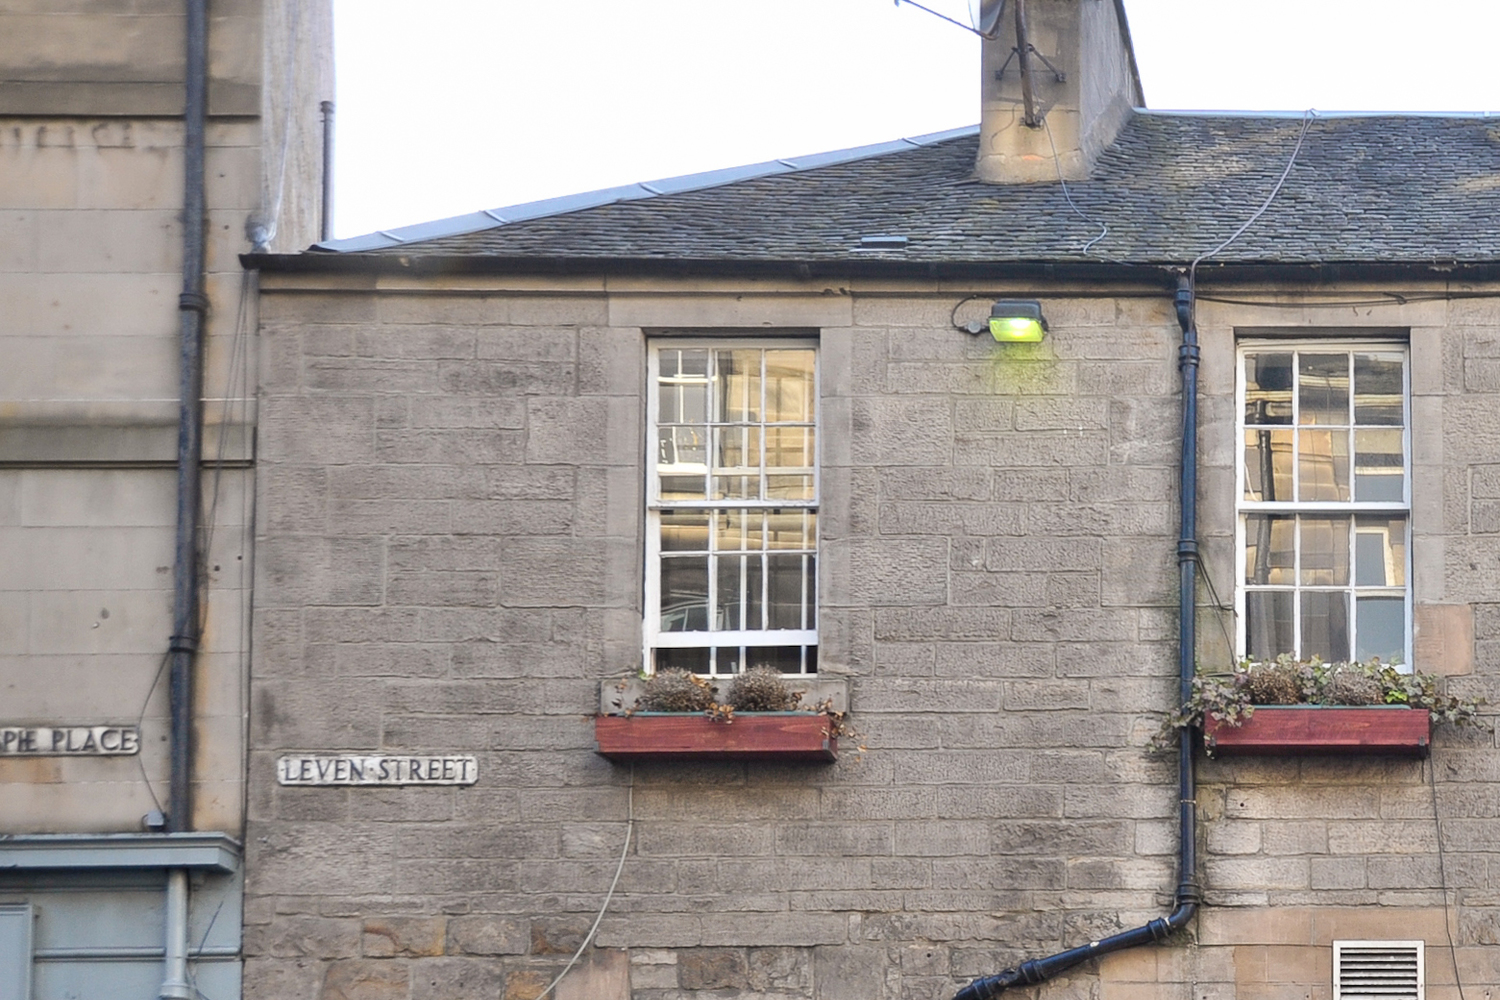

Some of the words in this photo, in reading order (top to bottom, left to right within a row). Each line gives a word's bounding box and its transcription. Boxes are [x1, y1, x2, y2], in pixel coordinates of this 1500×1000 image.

[51, 729, 135, 752] PLACE
[284, 759, 365, 781] LEVEN
[378, 758, 474, 781] STREET
